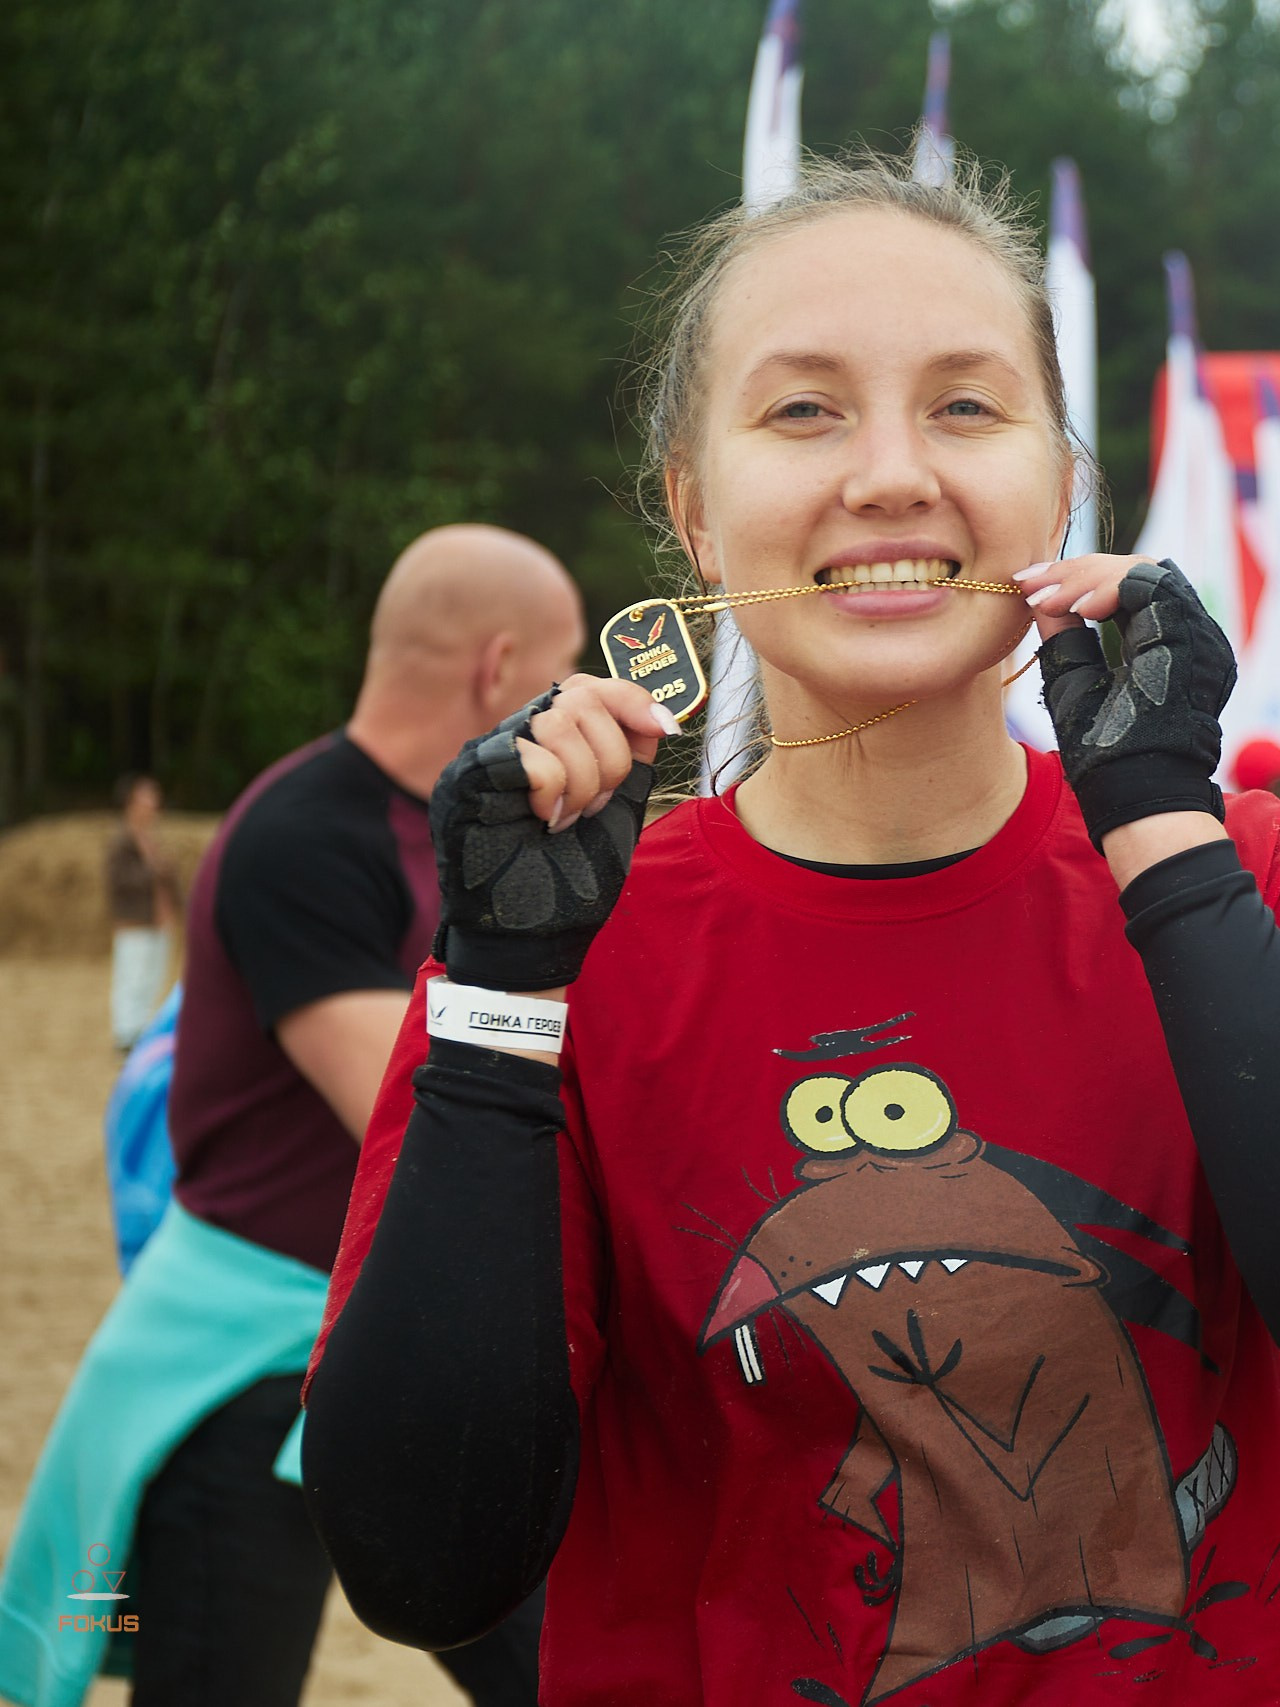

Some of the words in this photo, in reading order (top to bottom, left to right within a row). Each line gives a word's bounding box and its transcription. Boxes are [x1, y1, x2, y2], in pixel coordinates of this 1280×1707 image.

[629, 643, 671, 667] ГОНКА
[630, 653, 678, 680] ГЕРОЕВ
[651, 678, 687, 703] 025
[469, 1012, 522, 1028] ГОНКА
